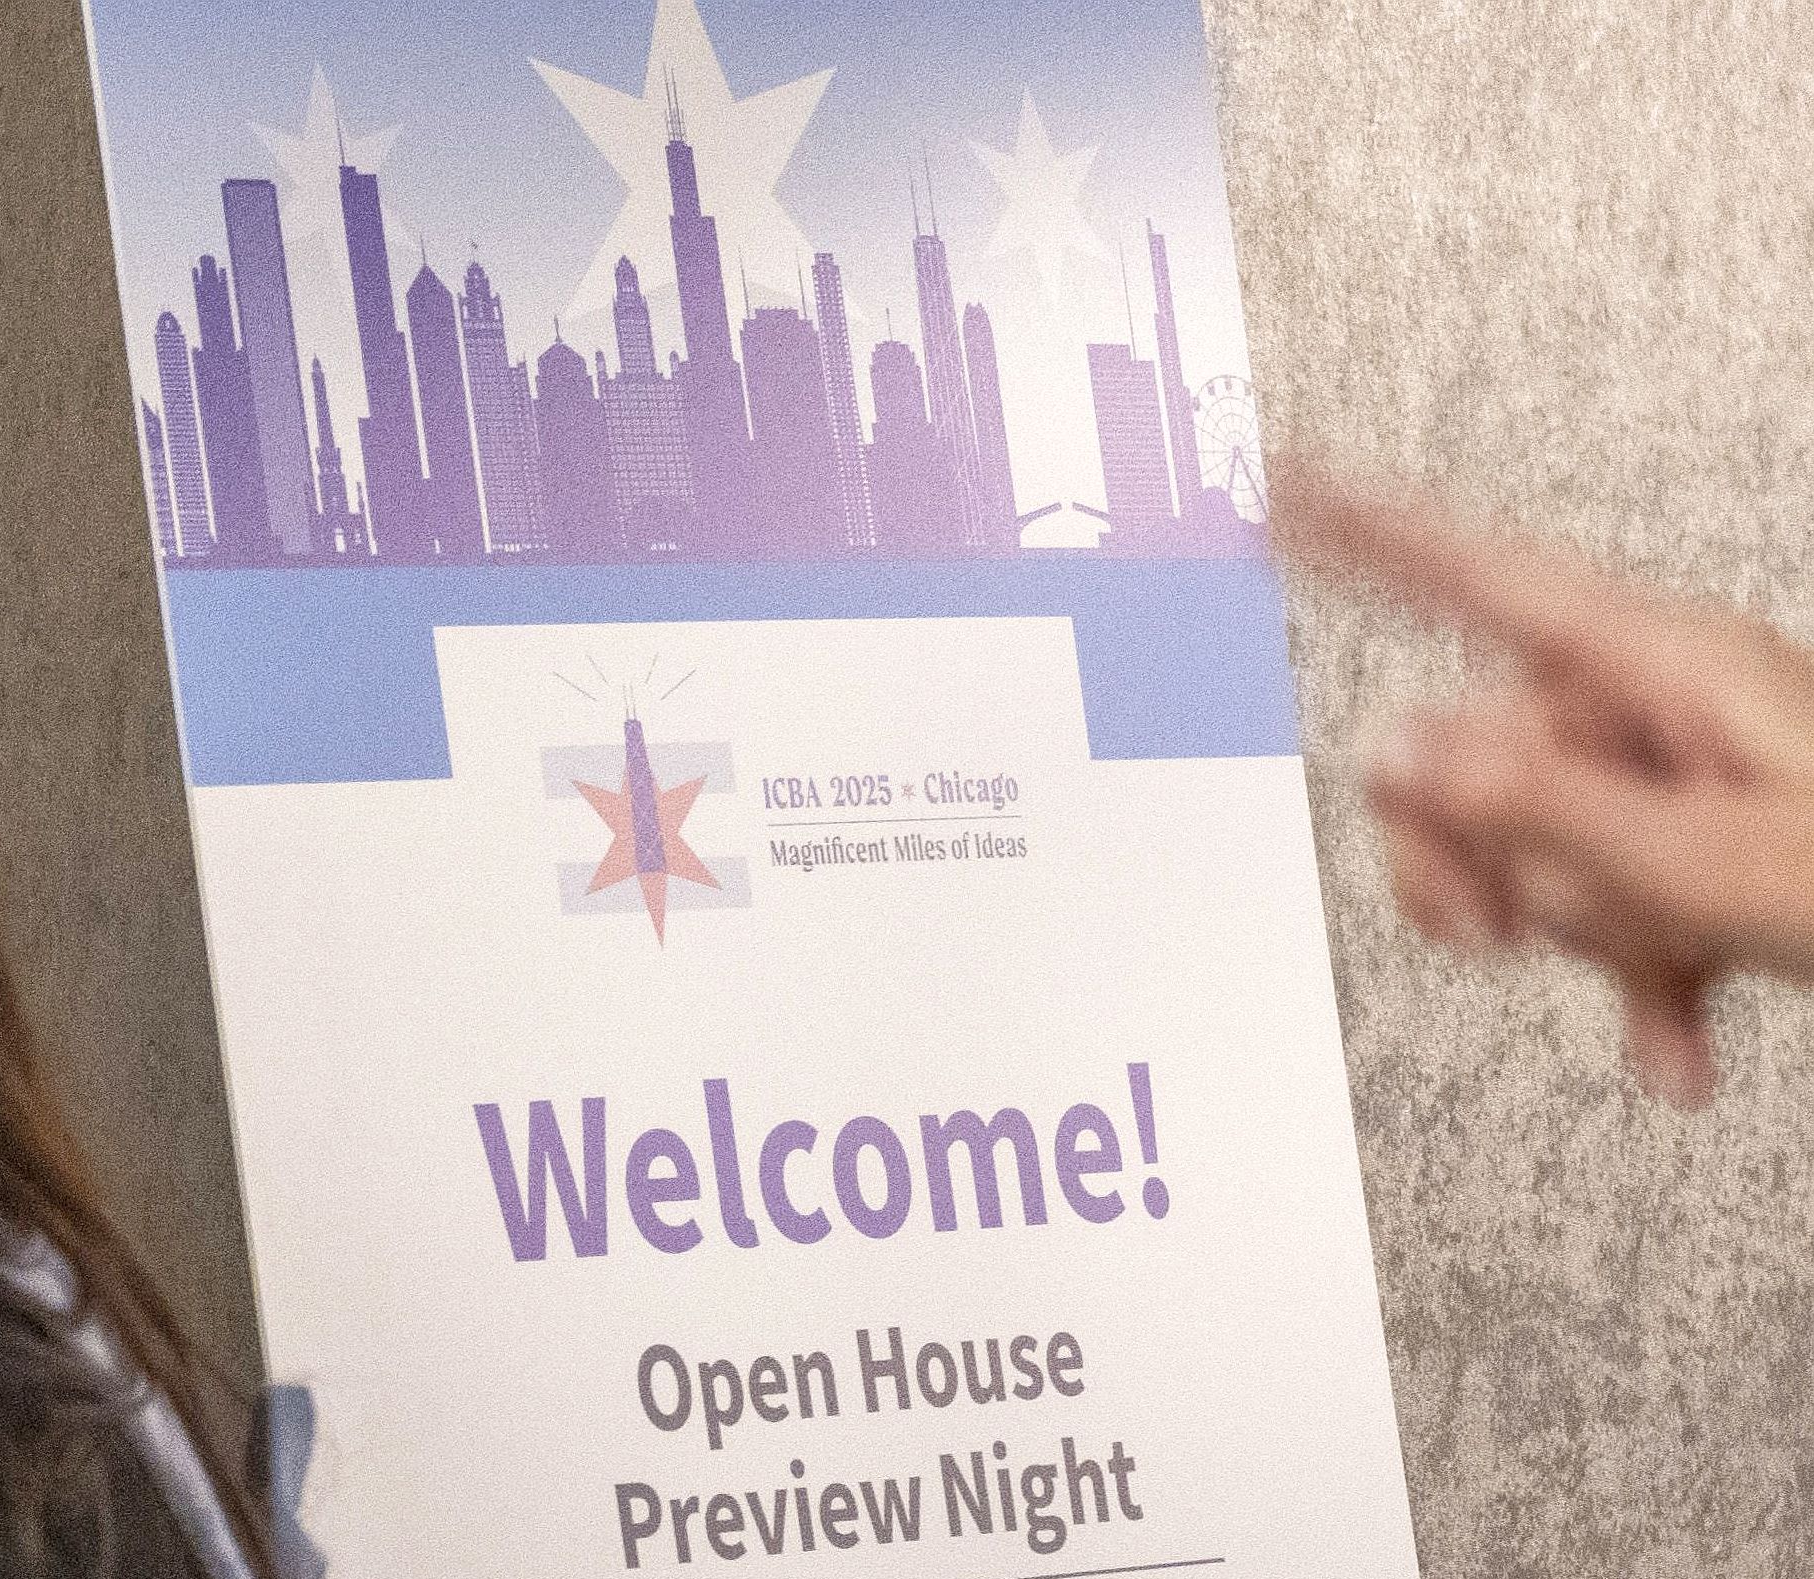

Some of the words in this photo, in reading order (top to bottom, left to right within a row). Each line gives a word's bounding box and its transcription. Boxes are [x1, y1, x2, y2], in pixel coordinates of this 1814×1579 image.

[762, 776, 820, 810] ICBA
[830, 775, 893, 807] 2025
[923, 771, 1019, 811] Chicago
[769, 835, 888, 873] Magnificent
[895, 833, 948, 862] Miles
[951, 832, 971, 859] of
[975, 831, 1028, 859] Ideas
[473, 1062, 1171, 1262] Welcome!
[636, 1342, 840, 1450] Open
[856, 1326, 1086, 1413] House
[613, 1459, 922, 1569] Preview
[939, 1436, 1144, 1555] Night
